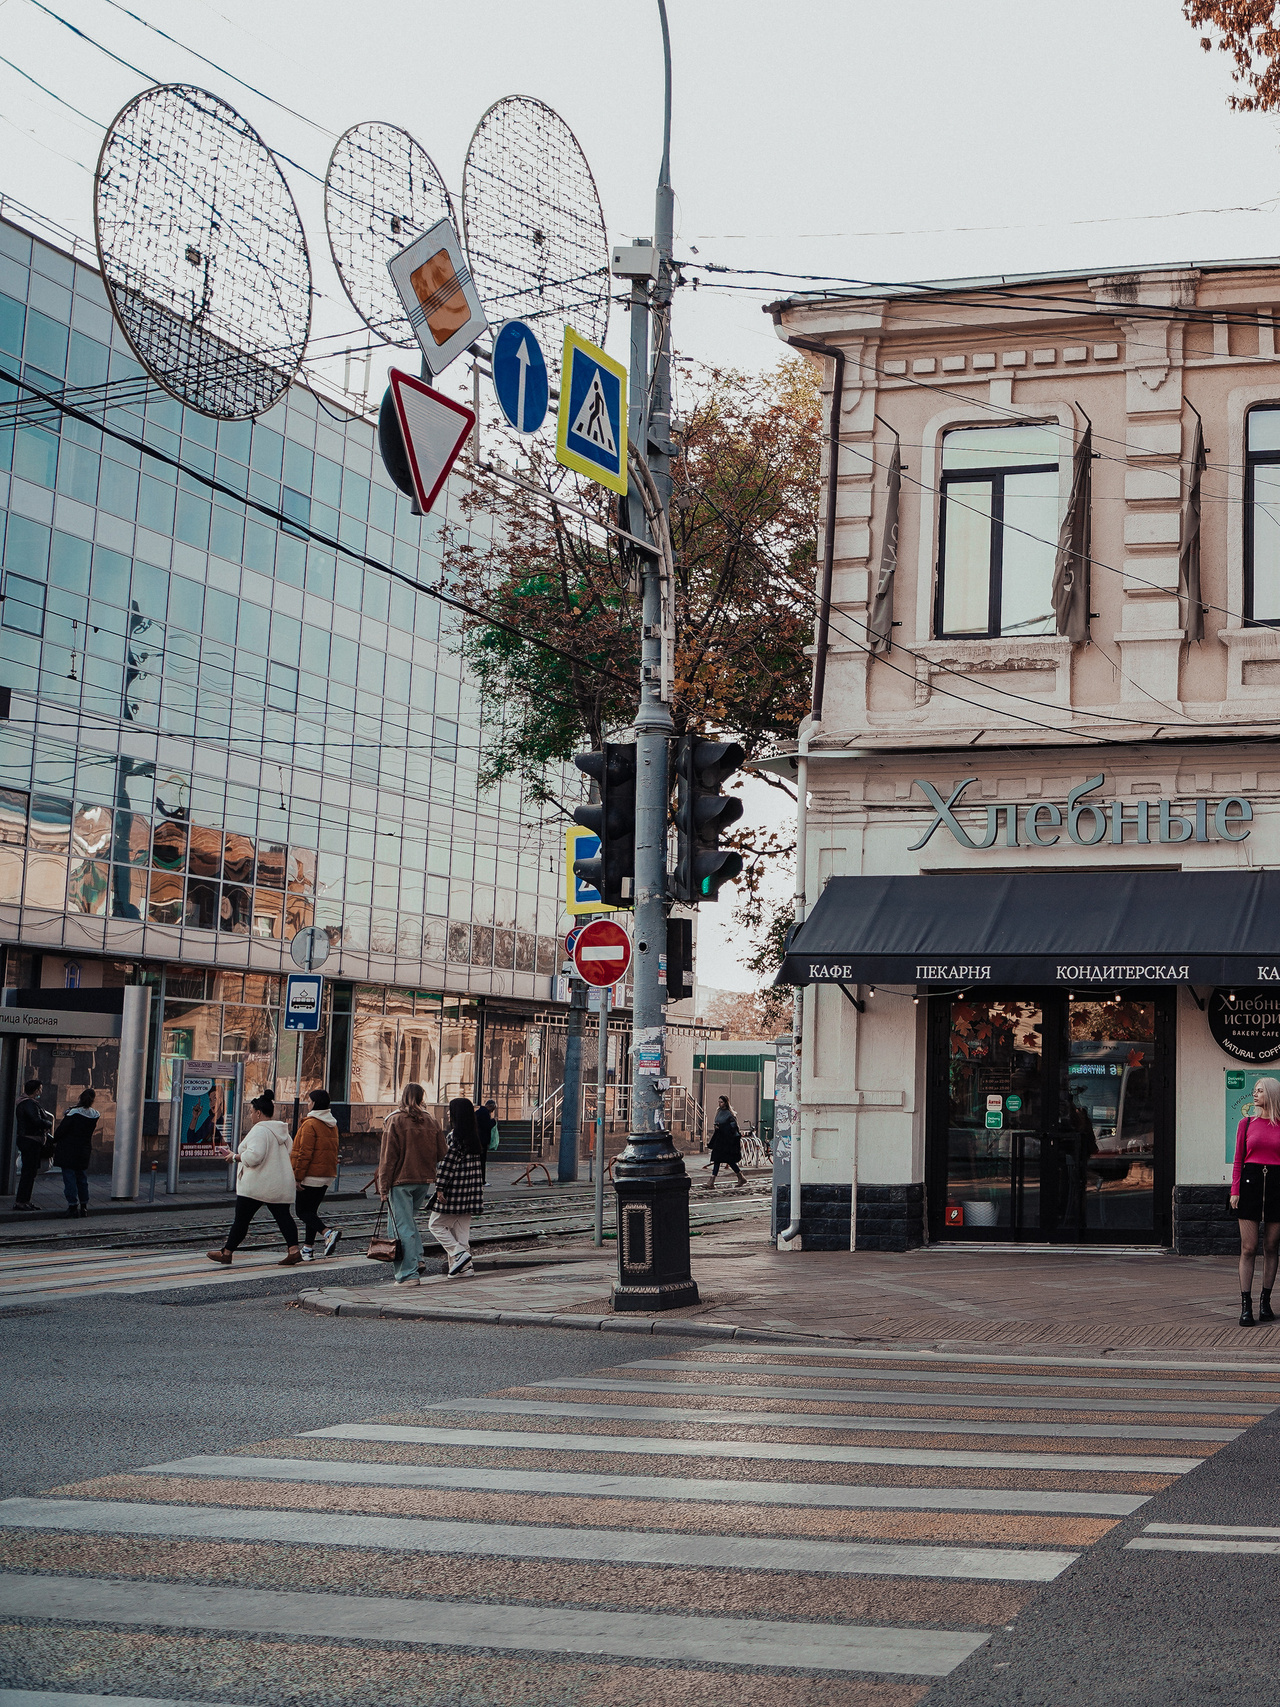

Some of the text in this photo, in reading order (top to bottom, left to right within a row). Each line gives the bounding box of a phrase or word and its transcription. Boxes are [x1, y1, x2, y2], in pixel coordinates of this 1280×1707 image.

[907, 773, 1254, 852] Хлебные
[809, 964, 853, 980] КАФЕ
[915, 965, 991, 981] ПЕКАРНЯ
[1056, 965, 1190, 981] КОНДИТЕРСКАЯ
[22, 1014, 58, 1026] Красная
[1222, 1038, 1255, 1059] NATURAL
